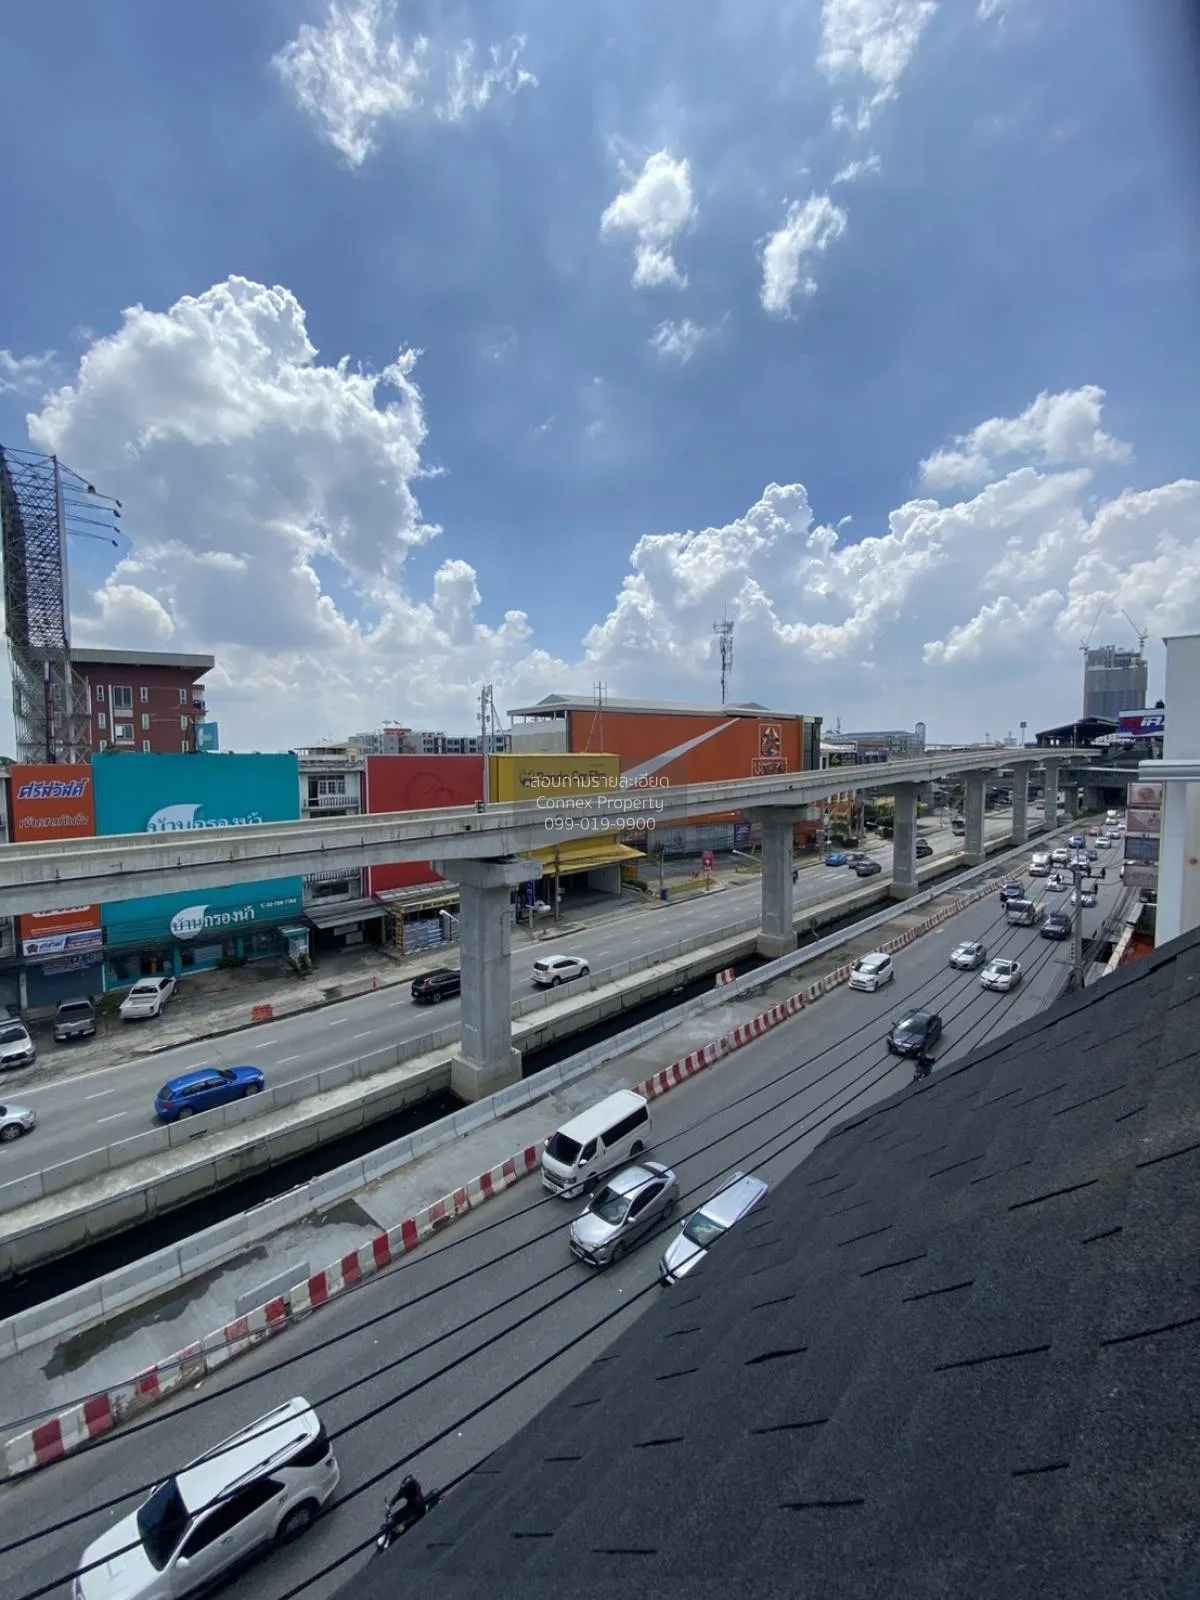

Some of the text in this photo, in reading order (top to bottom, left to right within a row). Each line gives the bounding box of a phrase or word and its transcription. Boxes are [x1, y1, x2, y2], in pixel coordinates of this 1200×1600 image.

[172, 905, 255, 932] บ้านกรองน้ำ
